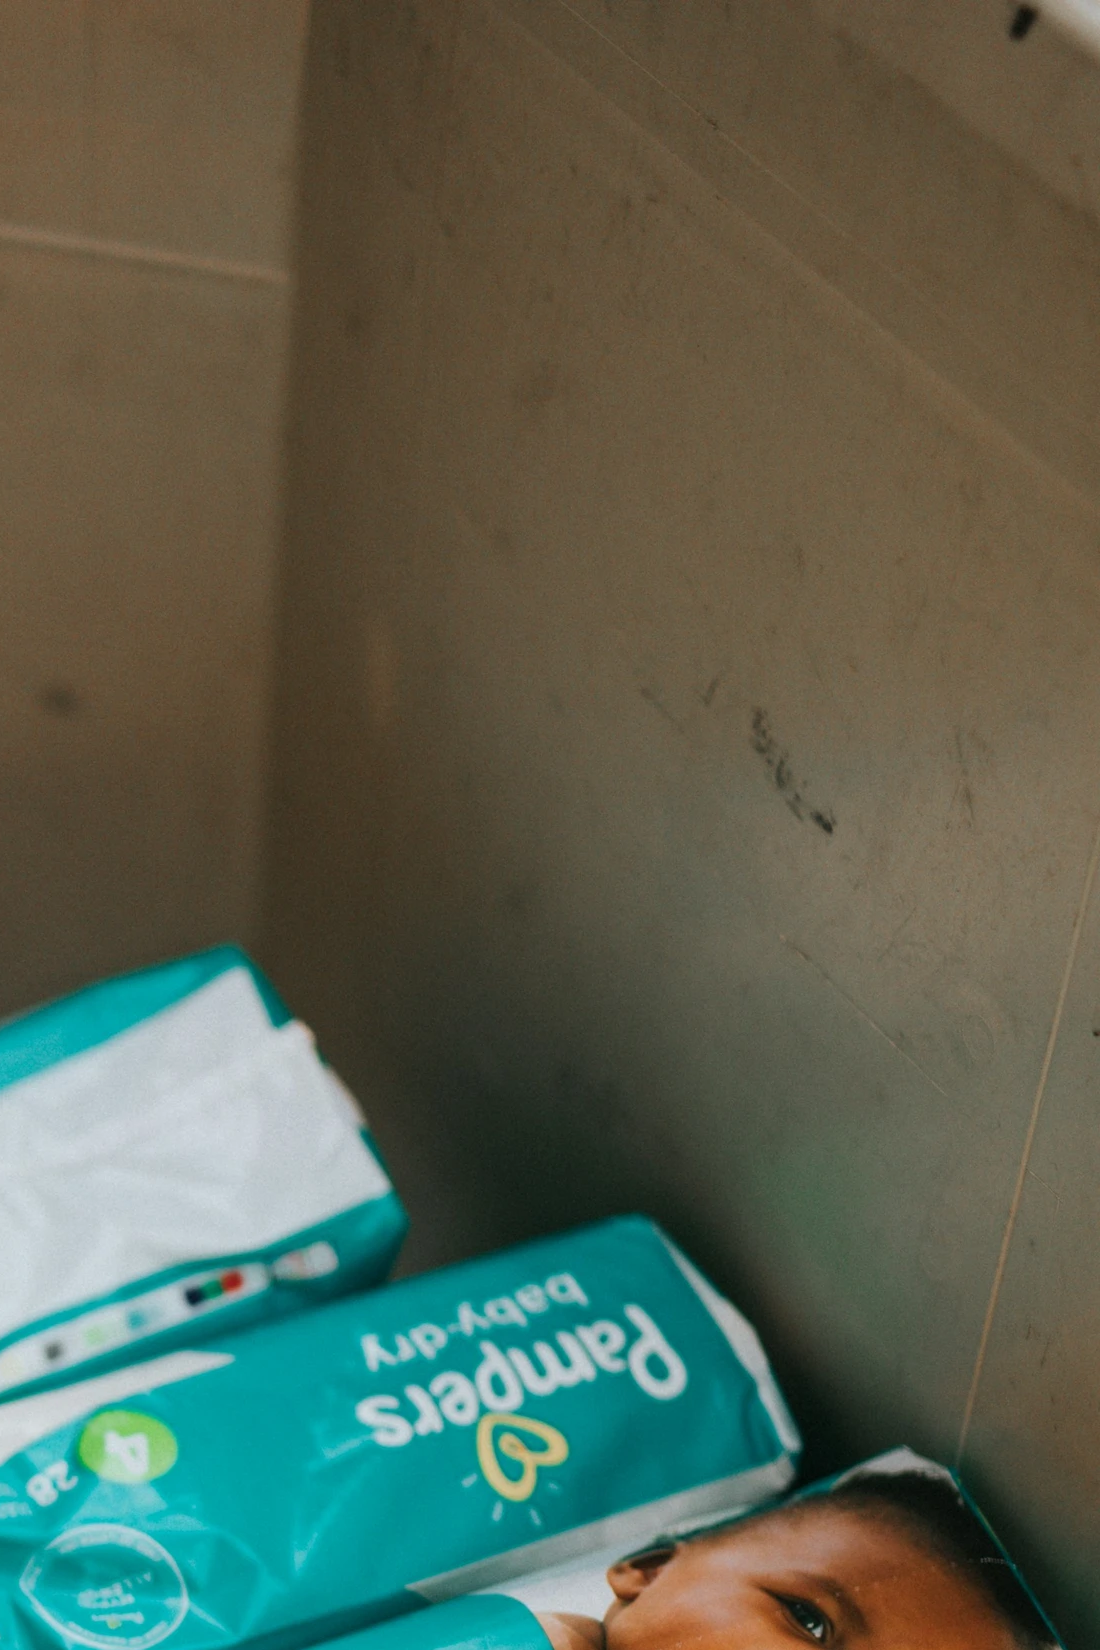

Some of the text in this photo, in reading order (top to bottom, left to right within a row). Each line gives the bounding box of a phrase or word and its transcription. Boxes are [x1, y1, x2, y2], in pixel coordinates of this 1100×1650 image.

[361, 1273, 588, 1372] baby-dry
[356, 1304, 688, 1448] Pampers
[25, 1461, 79, 1507] 28
[105, 1427, 151, 1472] 4
